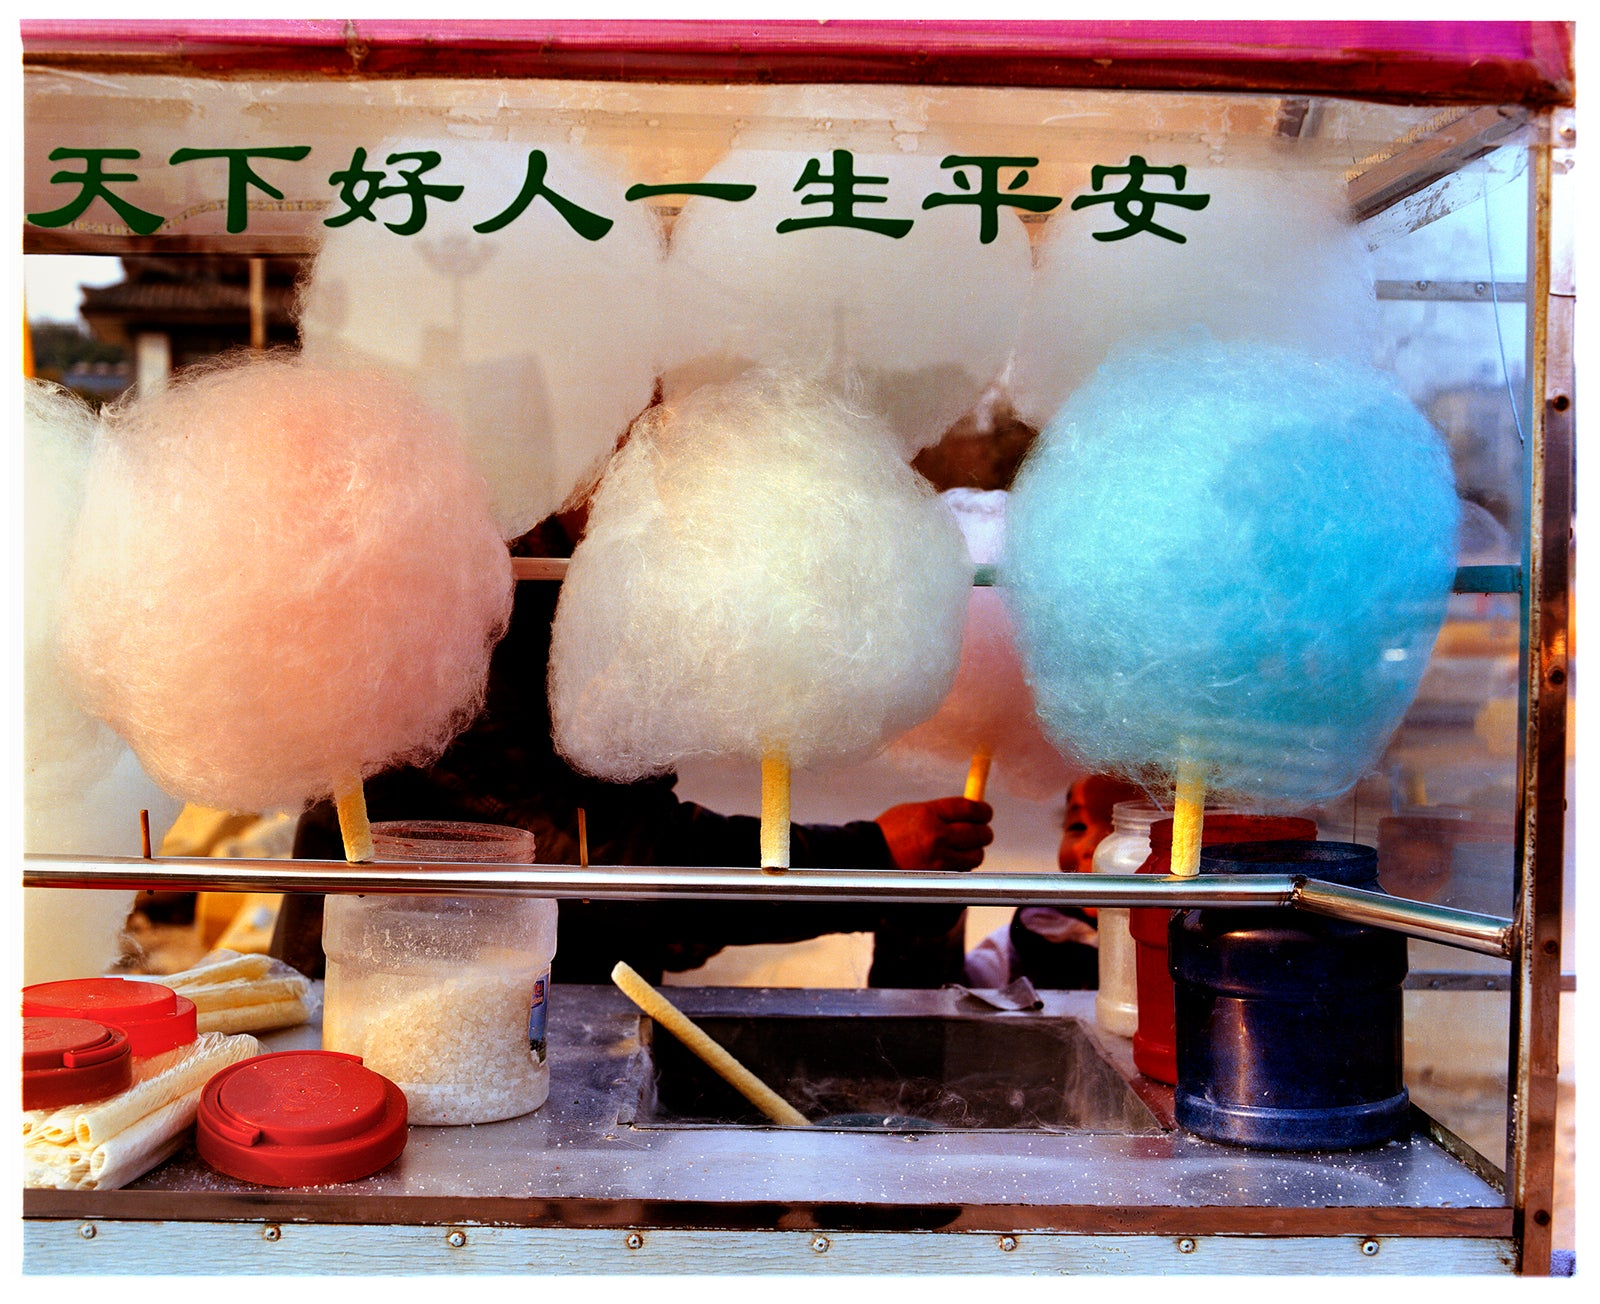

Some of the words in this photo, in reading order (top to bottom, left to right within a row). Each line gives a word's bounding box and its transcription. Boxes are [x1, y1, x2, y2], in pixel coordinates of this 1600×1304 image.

[27, 146, 1211, 245] 天下好人一生平安
